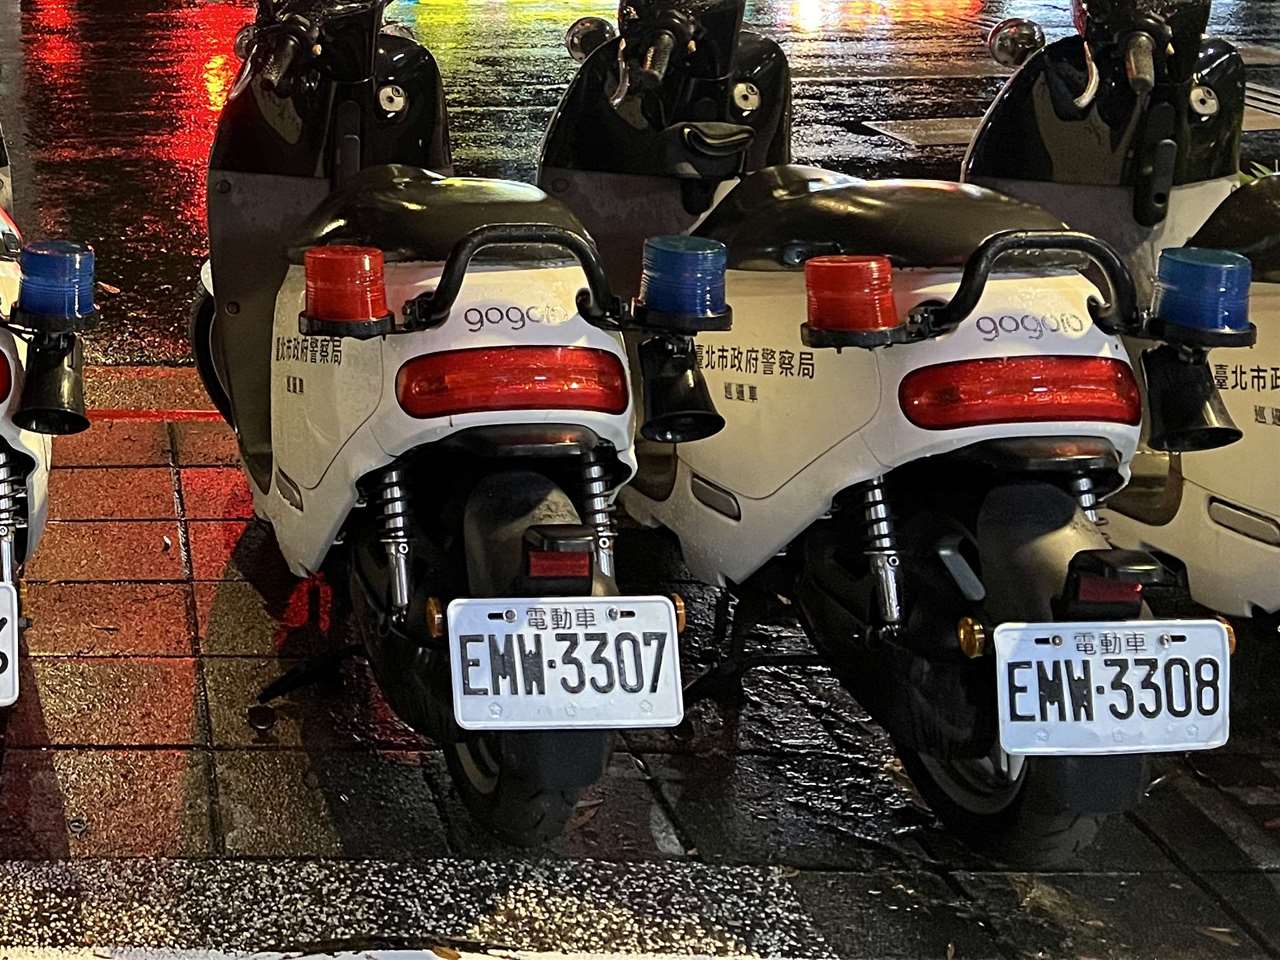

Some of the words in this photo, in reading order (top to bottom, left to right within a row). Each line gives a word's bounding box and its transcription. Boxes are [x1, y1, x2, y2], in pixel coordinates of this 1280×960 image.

[976, 313, 1083, 341] gogoro
[527, 608, 596, 630] 電動車
[1074, 632, 1147, 656] 電動車
